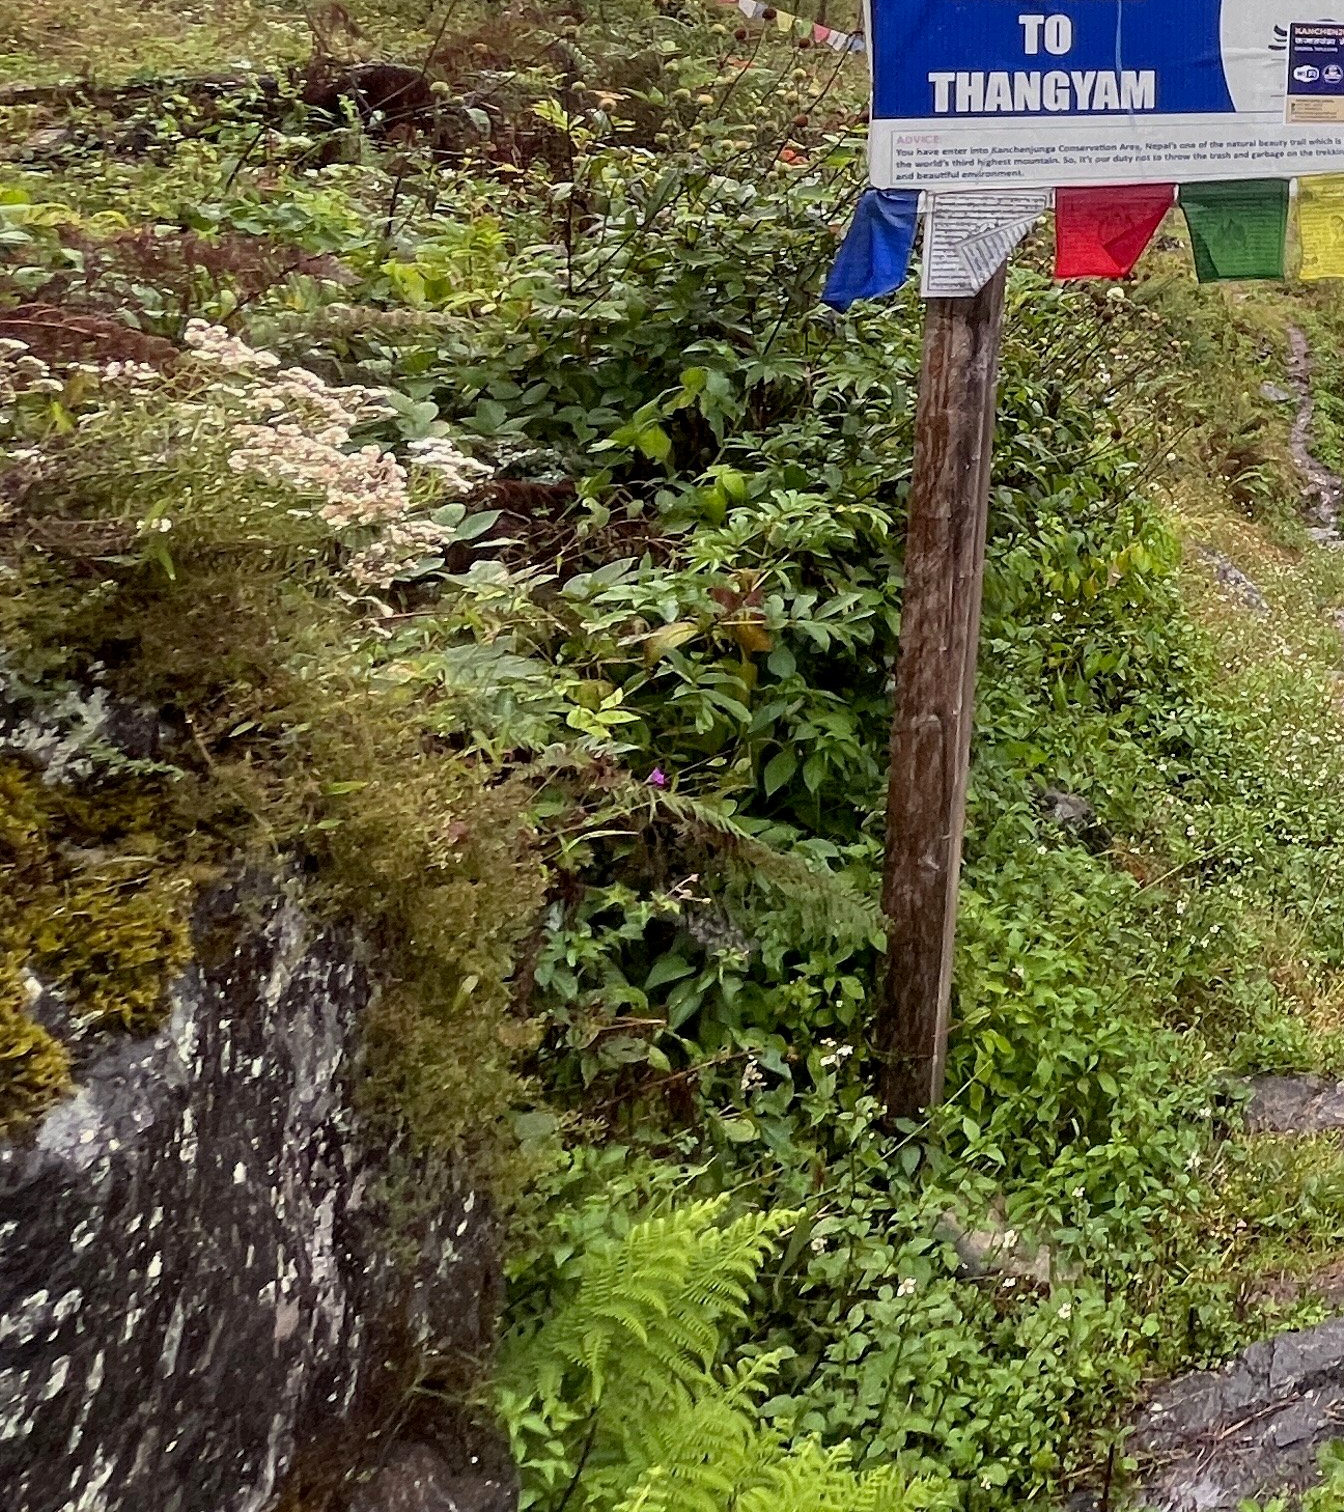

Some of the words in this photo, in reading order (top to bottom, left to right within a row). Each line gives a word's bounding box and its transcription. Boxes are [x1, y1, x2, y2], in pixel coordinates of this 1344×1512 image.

[1018, 14, 1072, 54] TO
[928, 71, 1155, 112] THANGYAM
[991, 146, 1055, 155] Kanchenjunga
[1059, 144, 1117, 152] Conservation
[1145, 142, 1177, 150] Nepal's
[1226, 140, 1256, 148] natural
[1259, 140, 1287, 148] beauty
[977, 159, 1012, 167] highest
[1113, 155, 1133, 163] duty
[1252, 151, 1284, 159] garbage
[917, 171, 959, 179] beautiful
